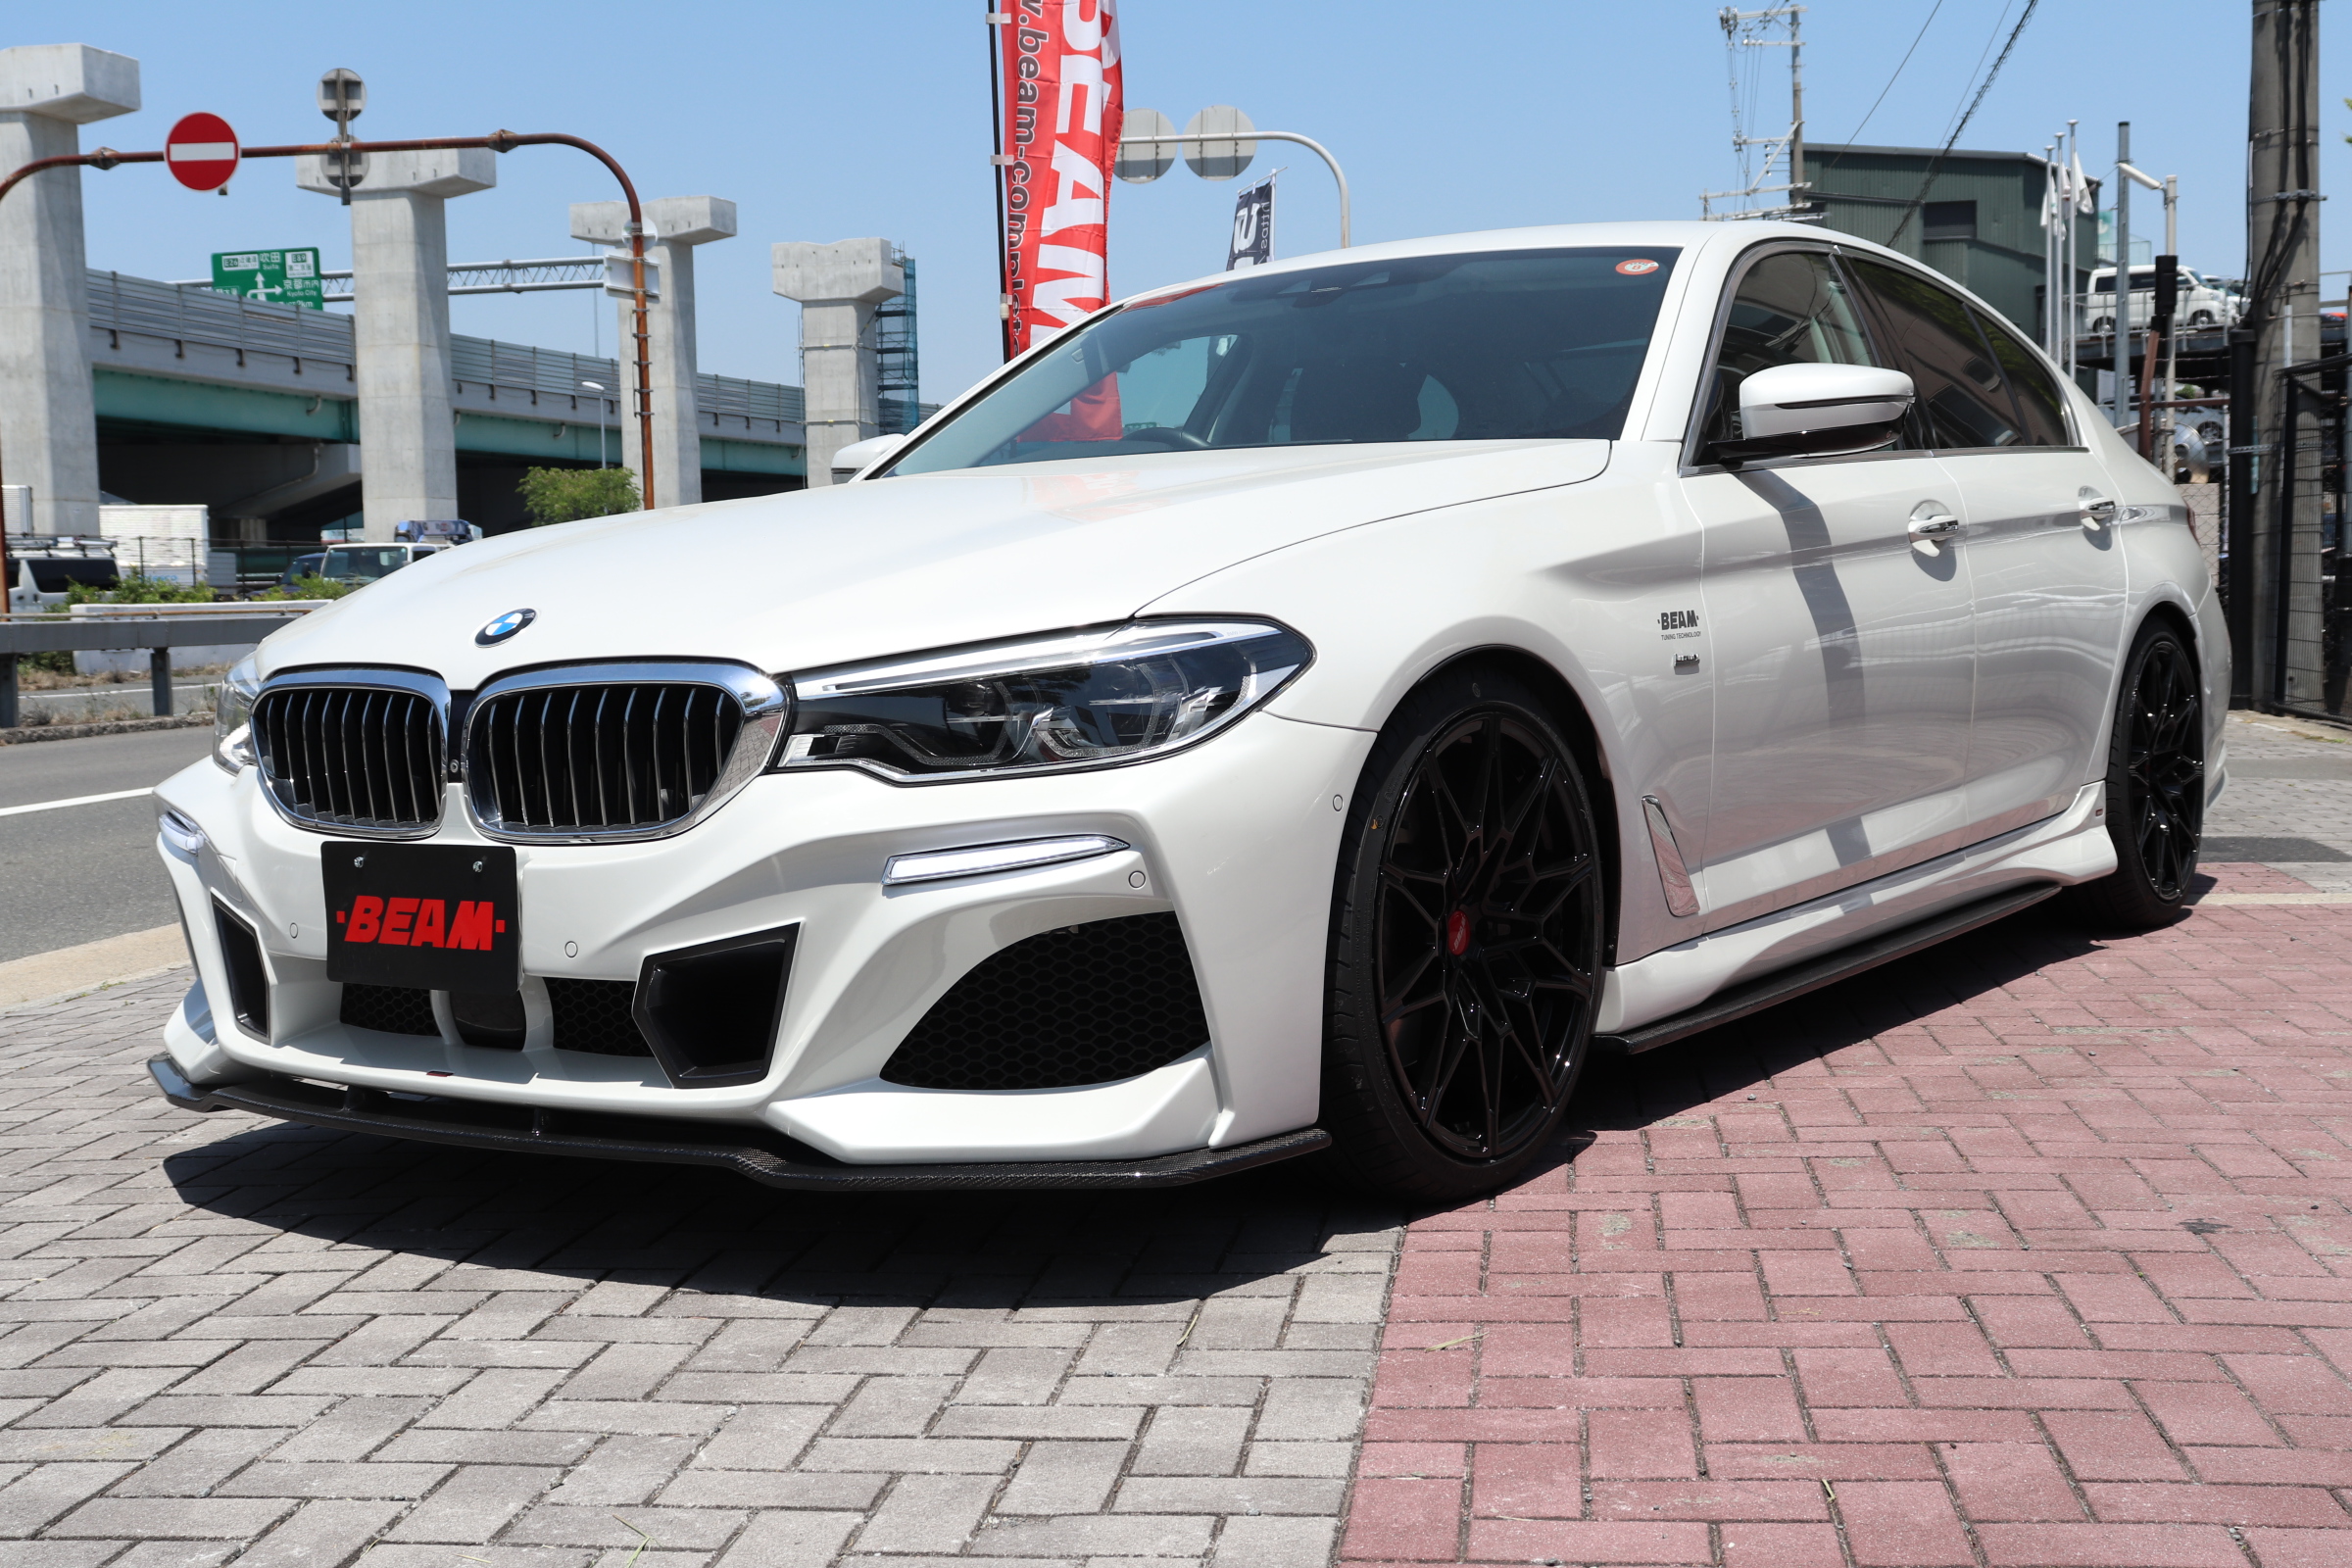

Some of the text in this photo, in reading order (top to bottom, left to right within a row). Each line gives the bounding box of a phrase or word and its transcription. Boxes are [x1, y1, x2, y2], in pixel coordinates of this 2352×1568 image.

[260, 252, 281, 263] 吹田
[292, 254, 307, 263] E89
[283, 279, 320, 290] 京都市内
[1660, 610, 1698, 630] BEAM
[344, 895, 495, 951] BEAM
